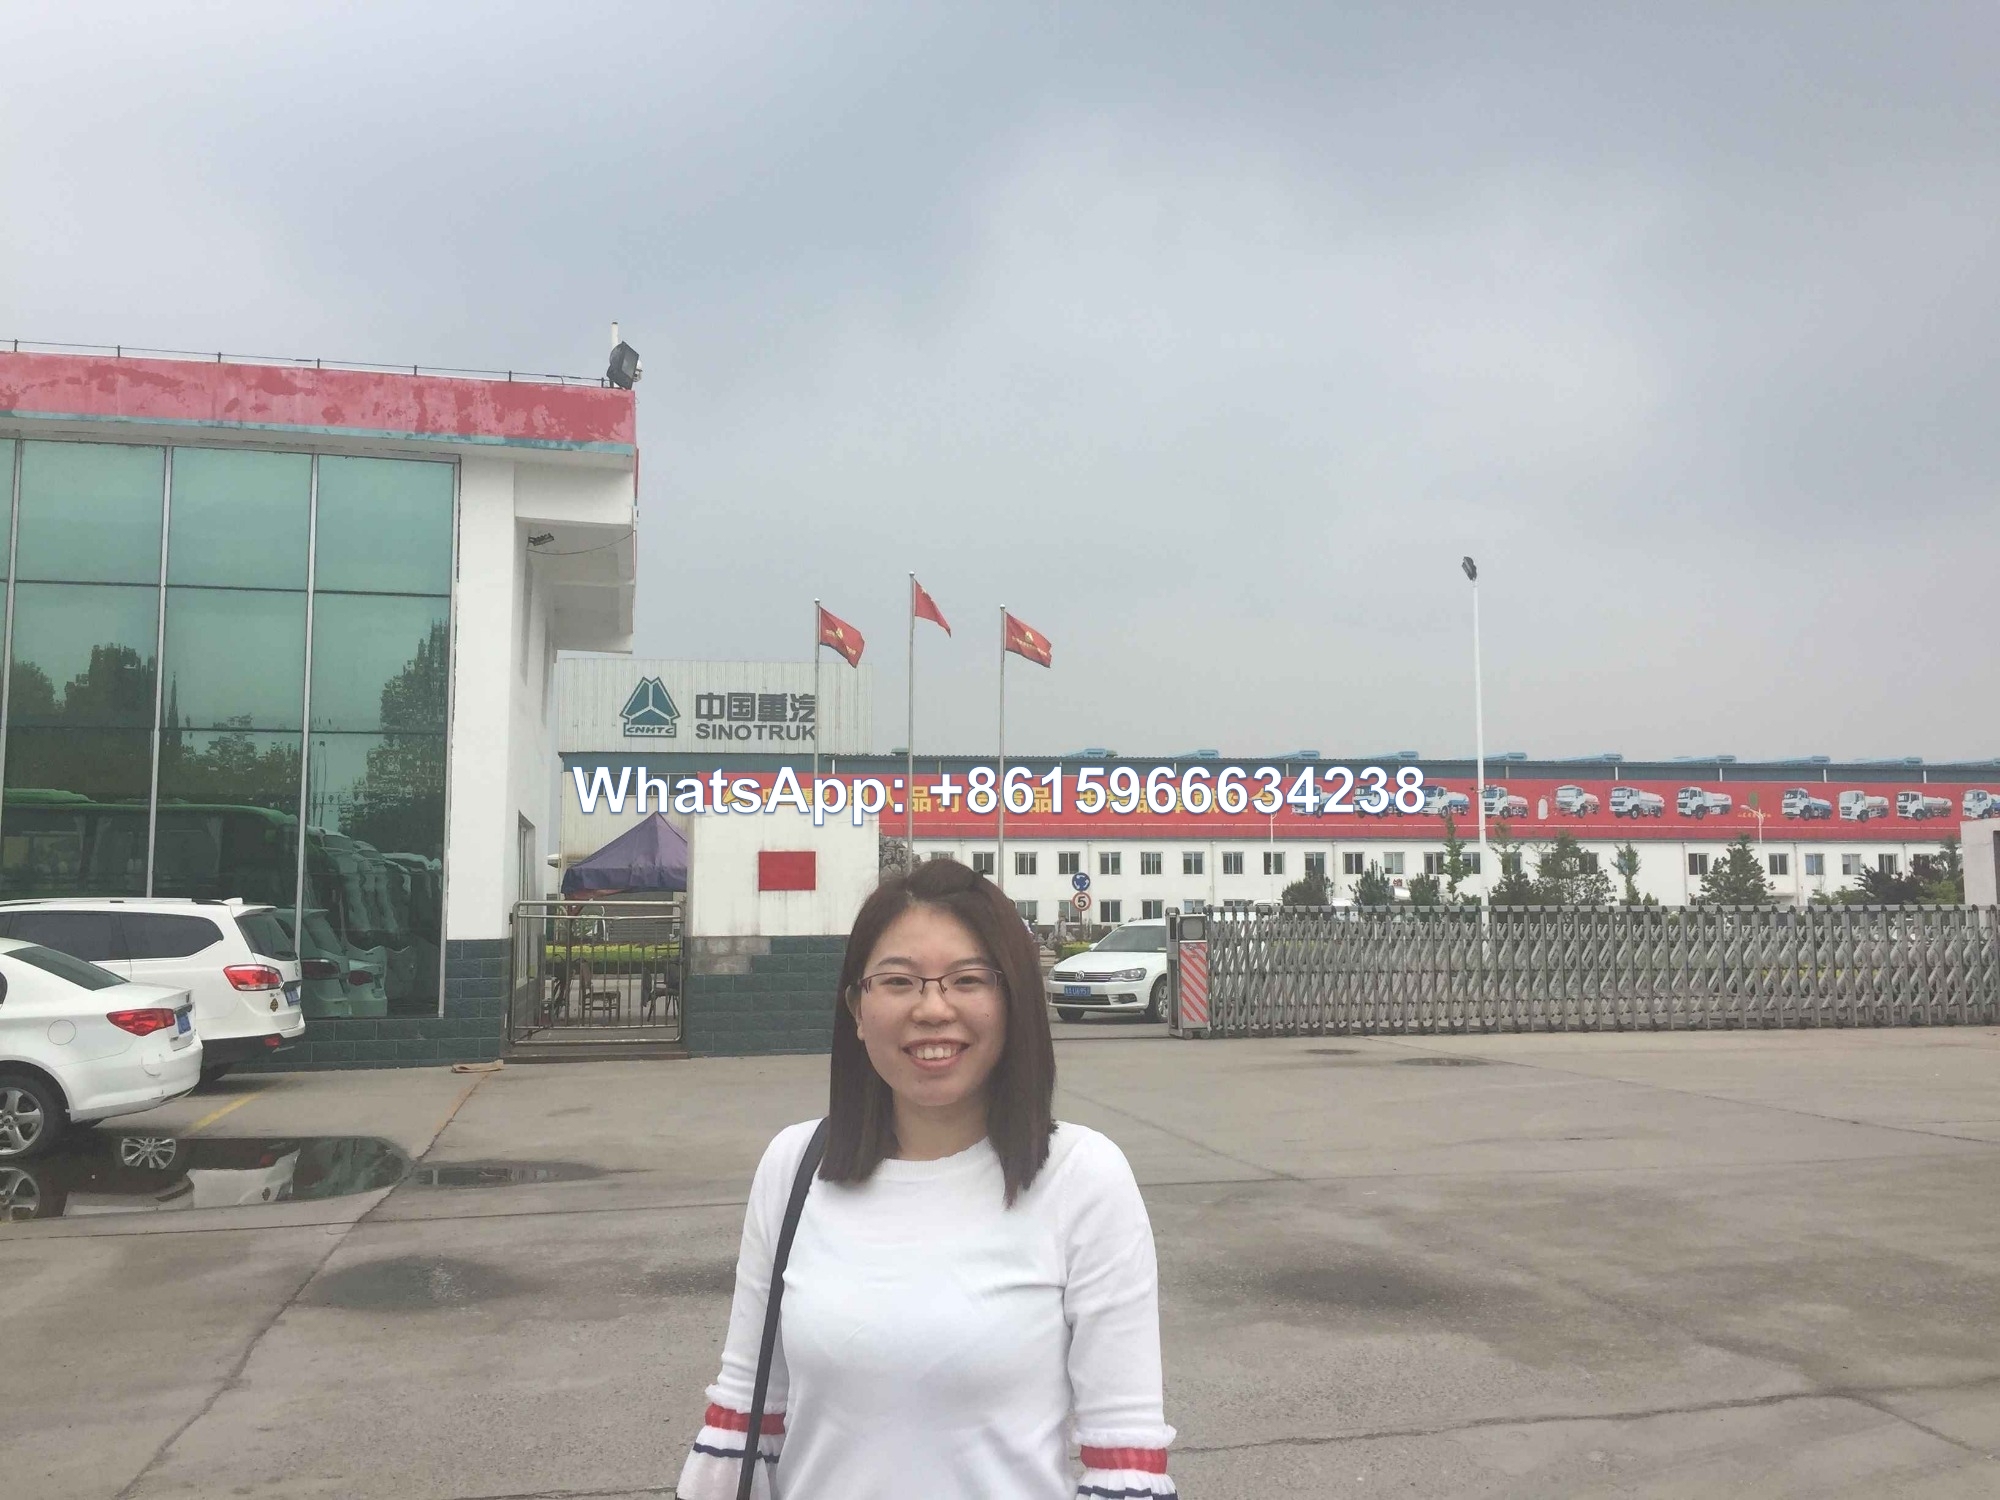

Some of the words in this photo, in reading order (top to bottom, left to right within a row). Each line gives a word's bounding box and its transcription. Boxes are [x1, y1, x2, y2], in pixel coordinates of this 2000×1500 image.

[695, 692, 815, 722] 中国重汽
[695, 723, 815, 741] SINOTRUK
[1078, 896, 1087, 908] 5
